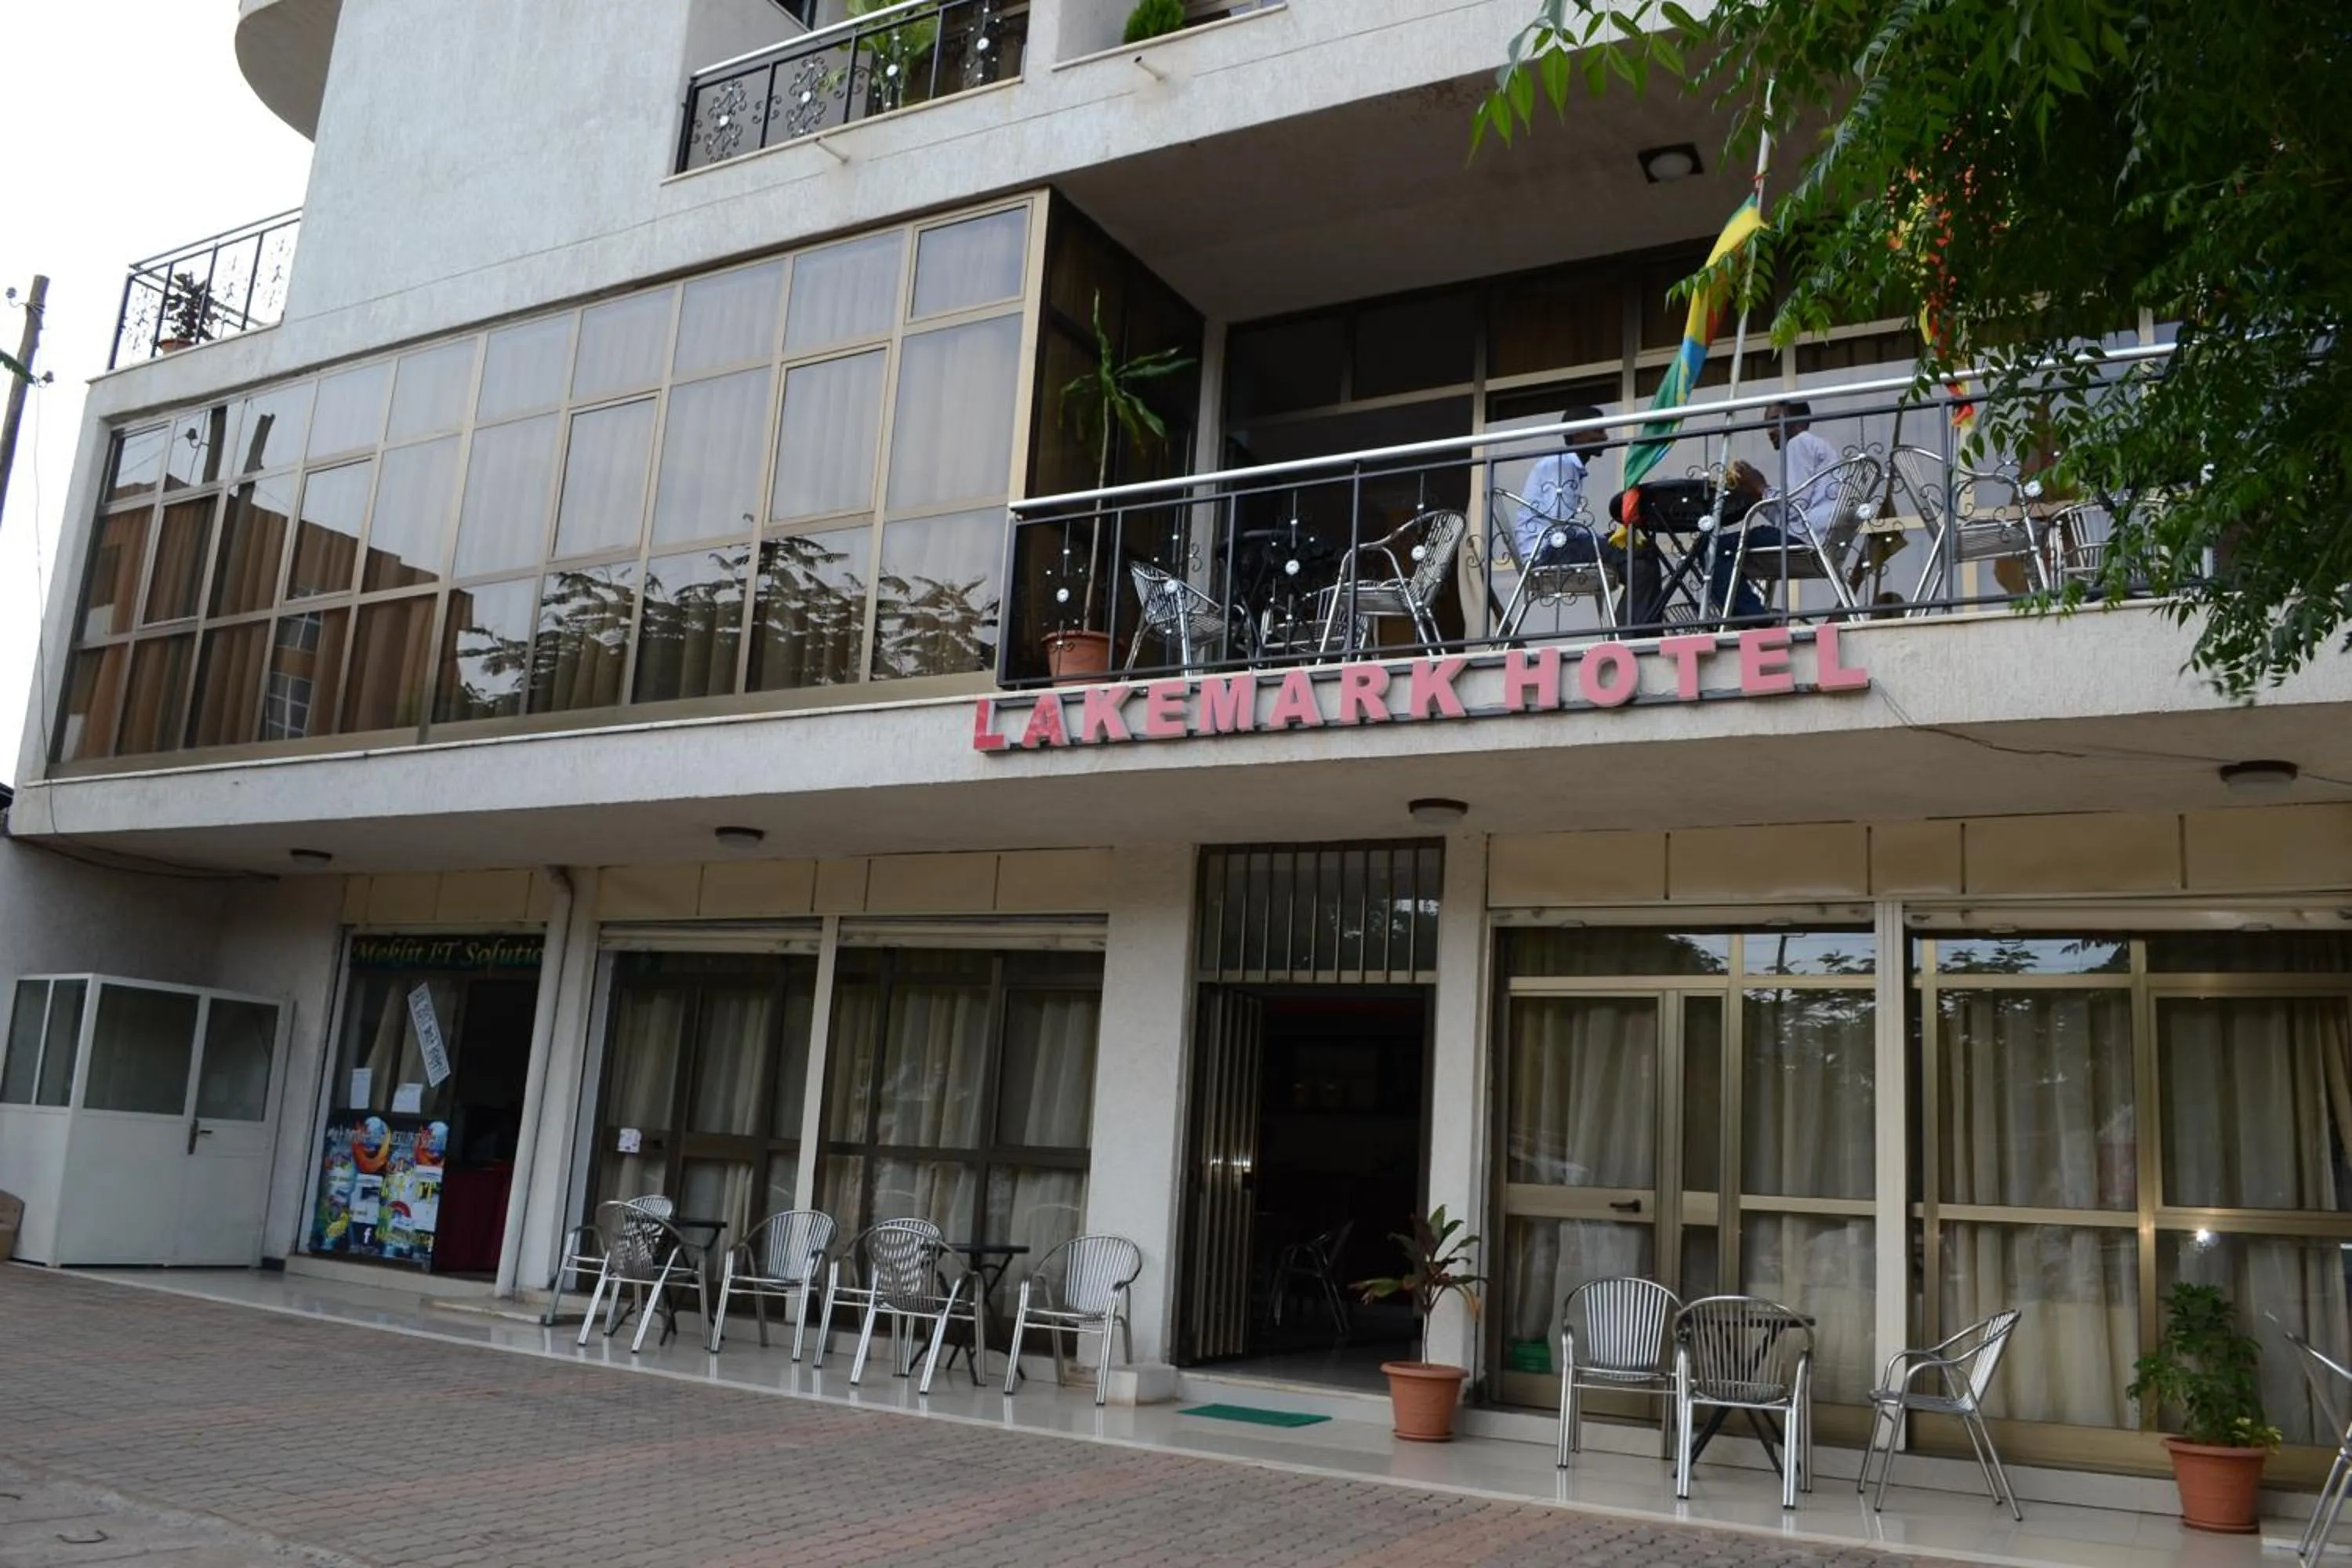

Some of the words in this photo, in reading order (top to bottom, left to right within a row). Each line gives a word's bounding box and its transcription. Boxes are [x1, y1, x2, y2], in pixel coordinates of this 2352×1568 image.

[973, 657, 1468, 753] LAKEMARK
[1504, 623, 1868, 711] HOTEL
[427, 940, 463, 964] IT
